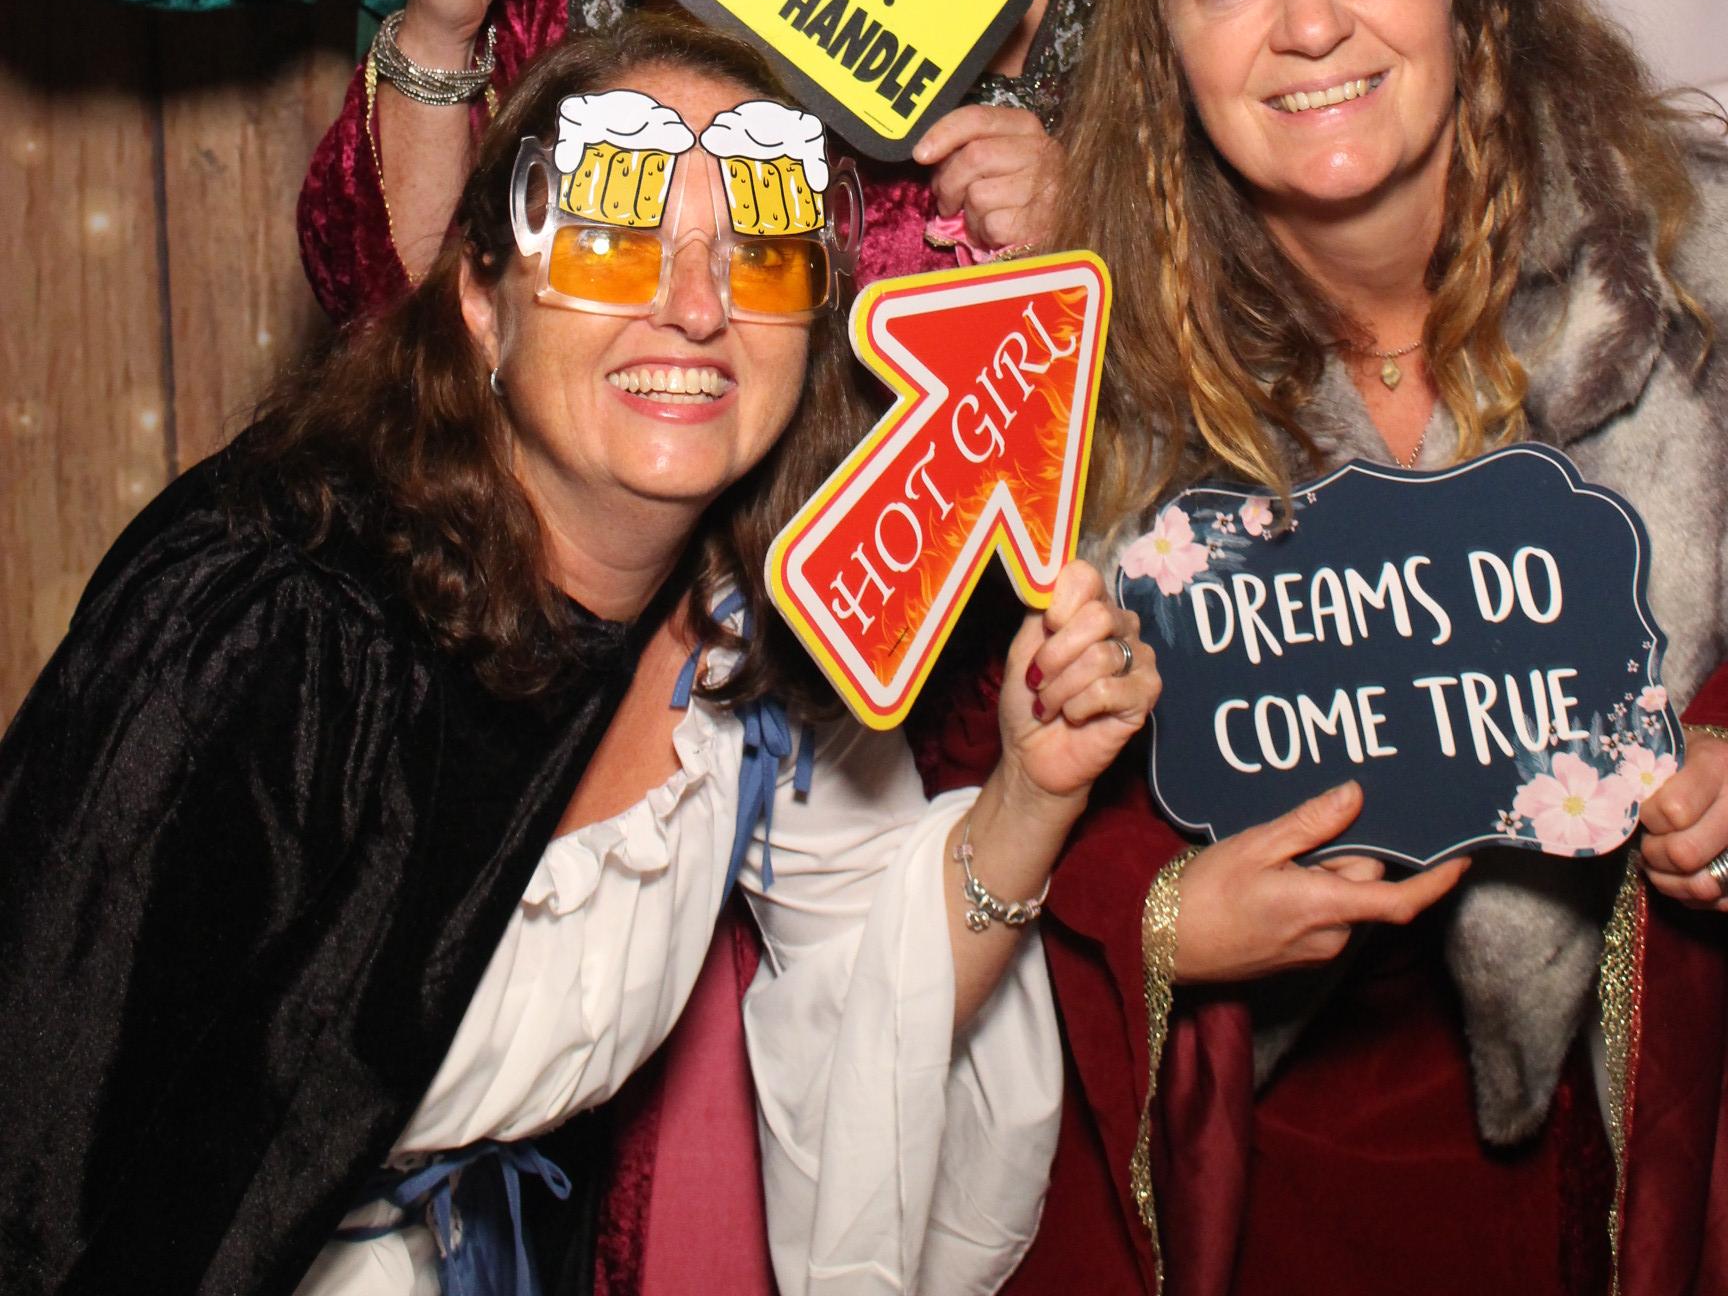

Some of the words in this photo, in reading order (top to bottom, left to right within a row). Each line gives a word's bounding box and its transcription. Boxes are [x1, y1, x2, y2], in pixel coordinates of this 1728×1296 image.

[830, 442, 954, 636] HOT
[951, 301, 1077, 464] GIRL
[1190, 555, 1452, 664] DREAMS
[1467, 546, 1562, 624] DO
[1213, 686, 1398, 773] COME
[1412, 668, 1589, 766] TRUE
